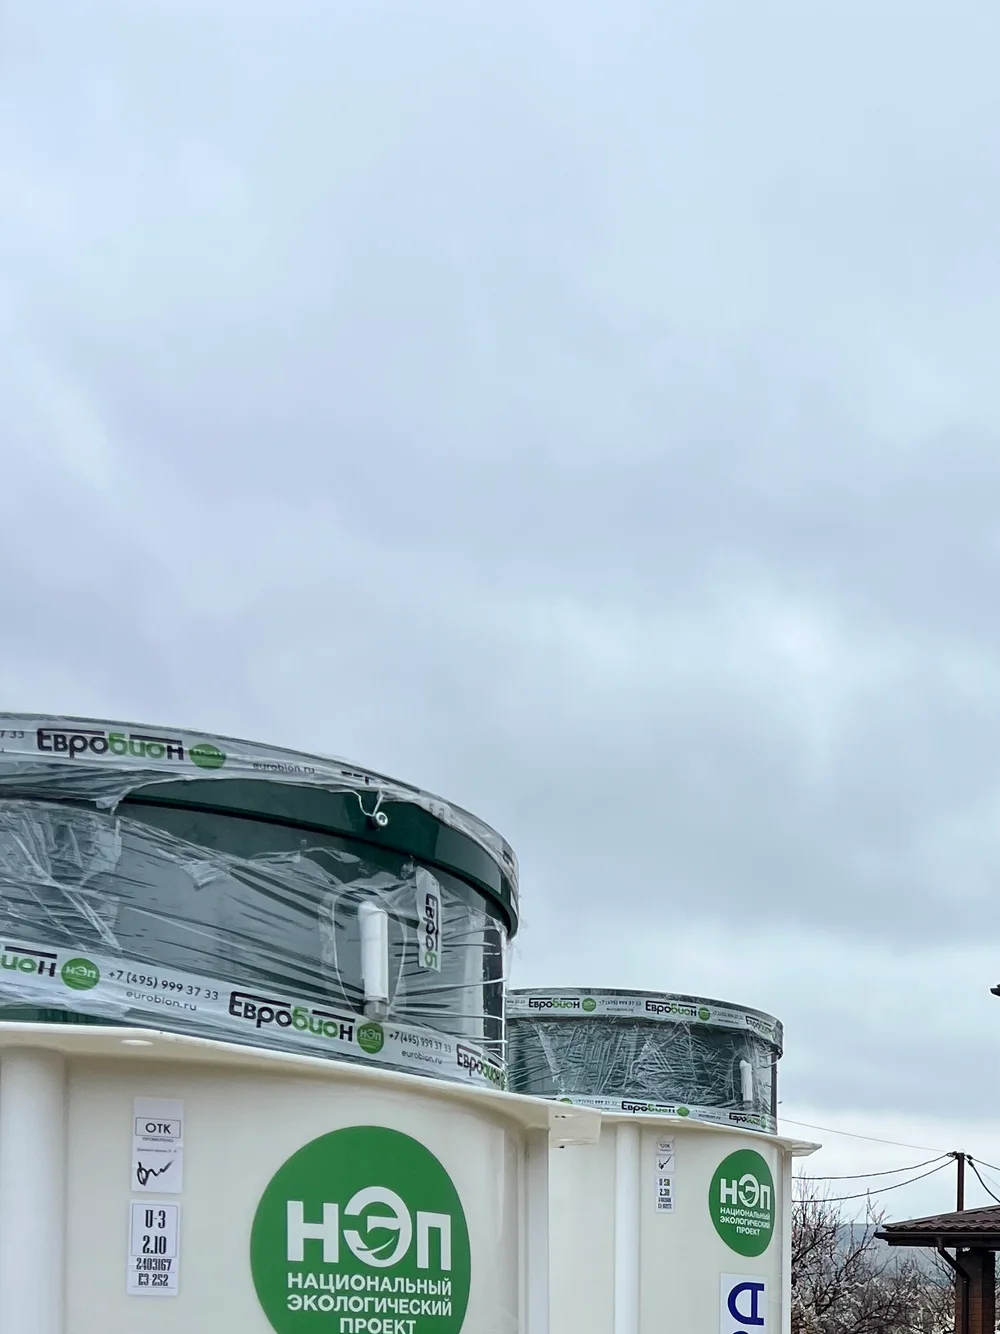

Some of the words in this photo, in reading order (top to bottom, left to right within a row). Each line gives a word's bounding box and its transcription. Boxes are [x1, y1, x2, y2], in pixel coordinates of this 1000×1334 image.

[37, 727, 184, 761] Евробион
[252, 762, 315, 774] eurobion.ru
[0, 945, 57, 978] ион
[108, 970, 124, 980] +7
[126, 971, 158, 989] (495)
[161, 980, 183, 993] 999
[186, 985, 201, 997] 37
[204, 989, 219, 1001] 33
[126, 991, 197, 1011] eurobion.ru
[528, 997, 580, 1011] Евробион
[645, 1000, 697, 1016] Евробион
[229, 991, 355, 1042] Евробион
[389, 1031, 399, 1040] +7
[400, 1032, 420, 1047] (495)
[145, 1122, 171, 1134] ОТК
[720, 1173, 770, 1210] НЭП
[720, 1207, 770, 1220] НАЦИОНАЛЬНЫЙ
[720, 1215, 770, 1229] ЭКОЛОГИЧЕСКИЙ
[287, 1186, 451, 1271] НЭП
[736, 1226, 760, 1236] ПРОЕКТ
[142, 1235, 167, 1254] 2.10
[287, 1272, 452, 1296] НАЦИОНАЛЬНЫЙ
[287, 1294, 452, 1317] ЭКОЛОГИЧЕСКИЙ
[340, 1317, 416, 1334] ПРОЕКТ
